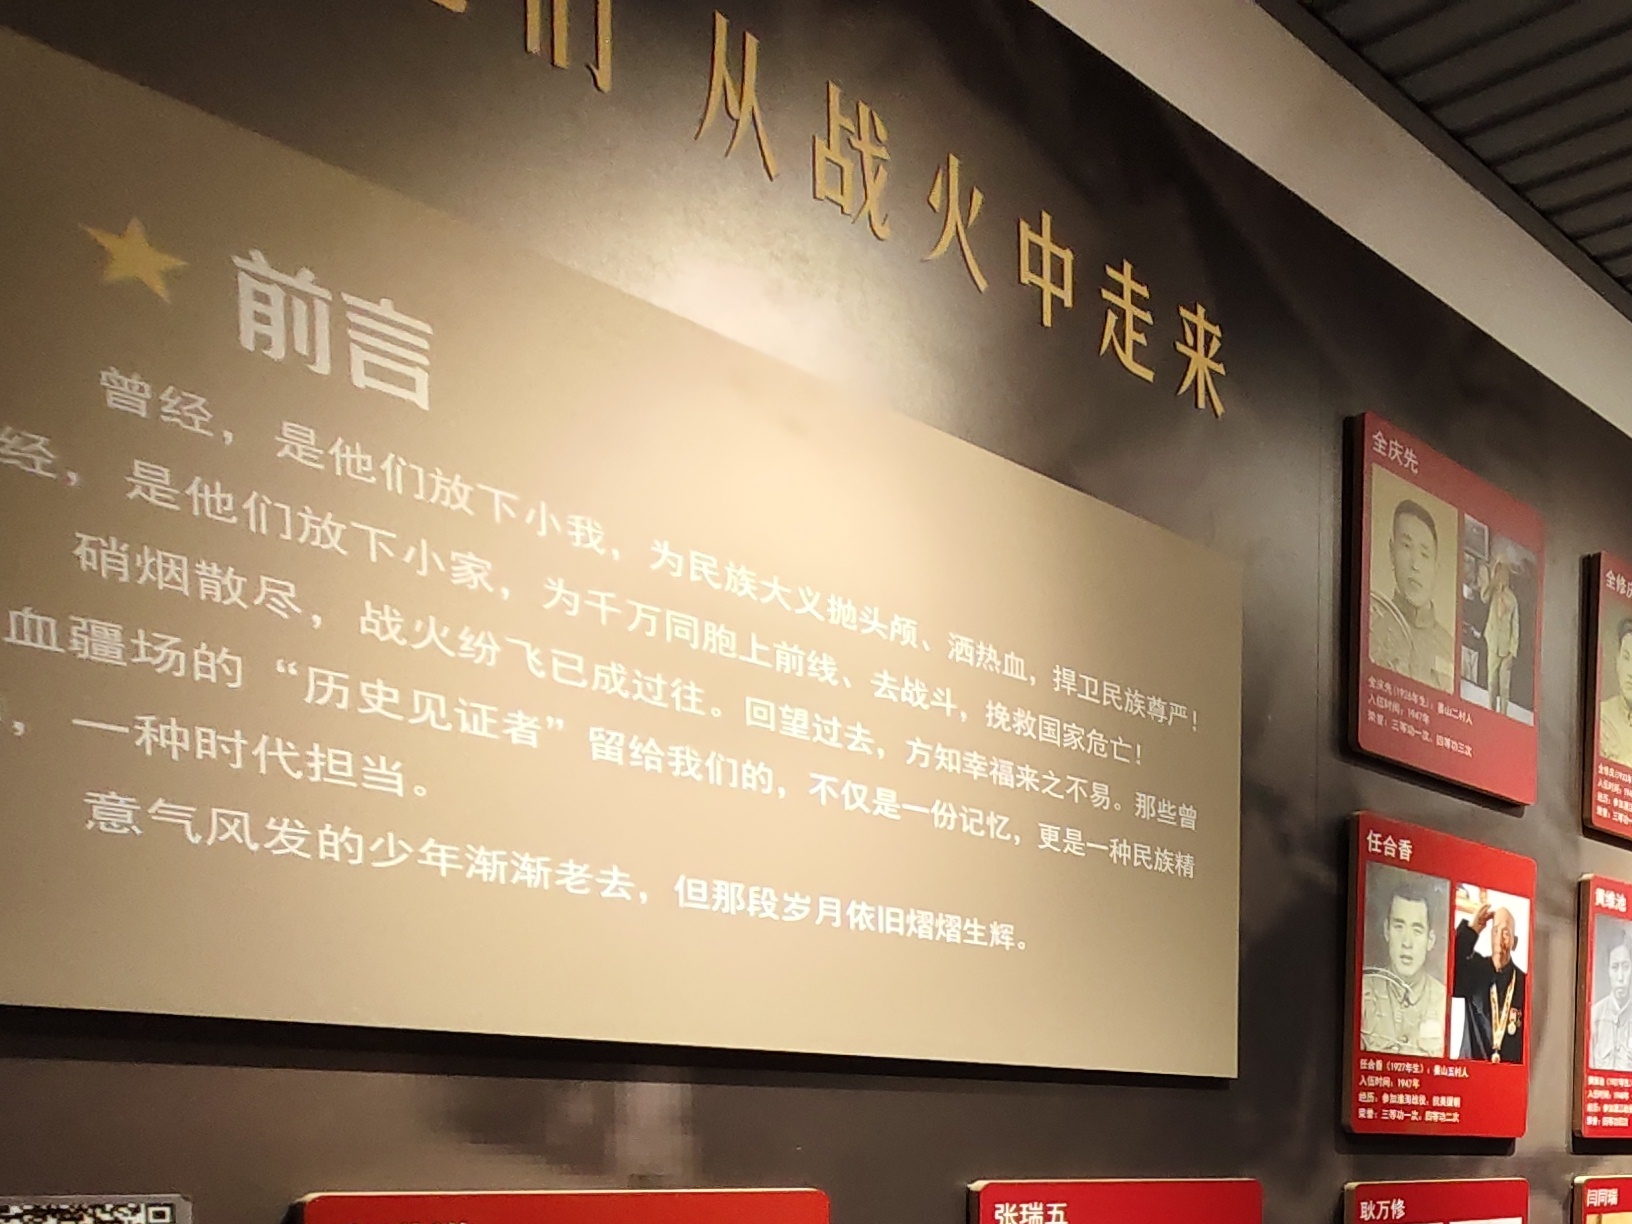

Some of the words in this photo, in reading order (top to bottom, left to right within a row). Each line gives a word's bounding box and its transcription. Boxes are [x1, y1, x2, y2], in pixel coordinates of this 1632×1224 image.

[231, 249, 434, 410] 前言
[1366, 829, 1413, 862] 任合香
[1360, 1198, 1406, 1222] 耿万修
